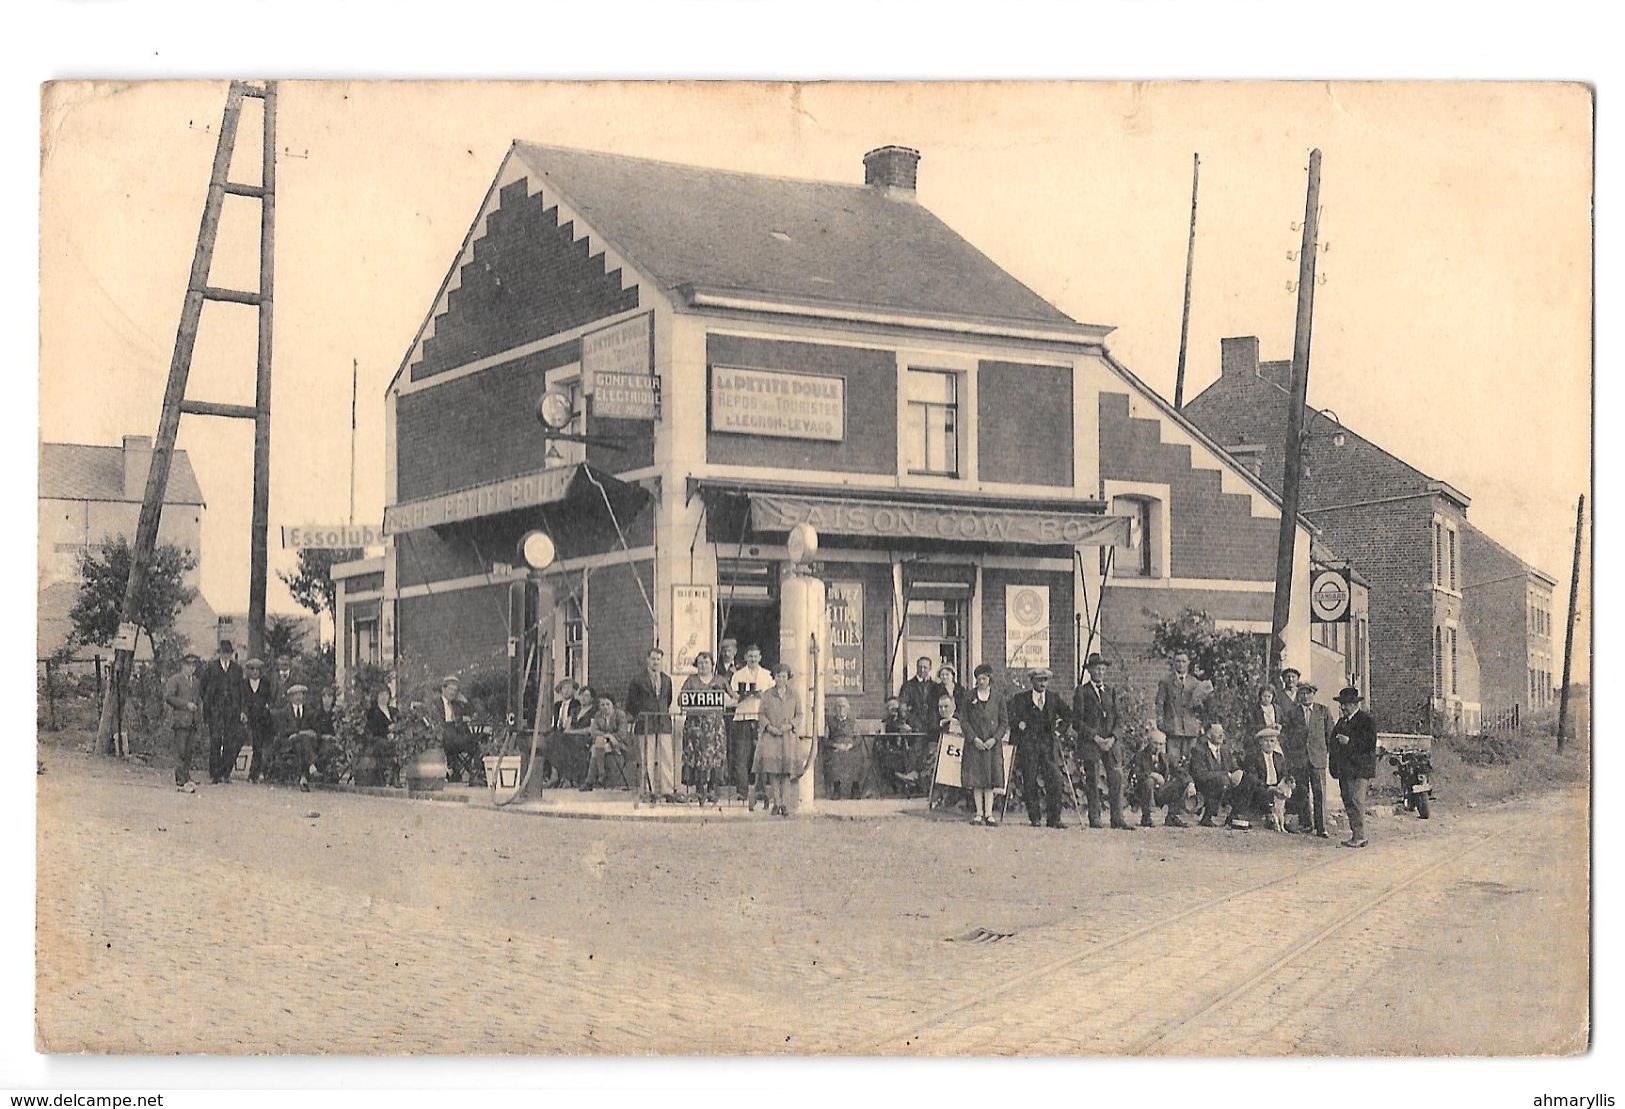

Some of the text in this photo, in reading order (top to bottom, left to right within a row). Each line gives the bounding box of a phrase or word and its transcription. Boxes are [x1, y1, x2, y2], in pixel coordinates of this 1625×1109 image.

[597, 373, 660, 389] GONFLEUR
[717, 376, 838, 399] LA PETITE POULE
[719, 391, 757, 409] REPOS
[776, 397, 839, 416] TOURISTES
[779, 503, 917, 534] SAISON
[290, 526, 387, 546] Essolube
[681, 693, 724, 706] BYRRH
